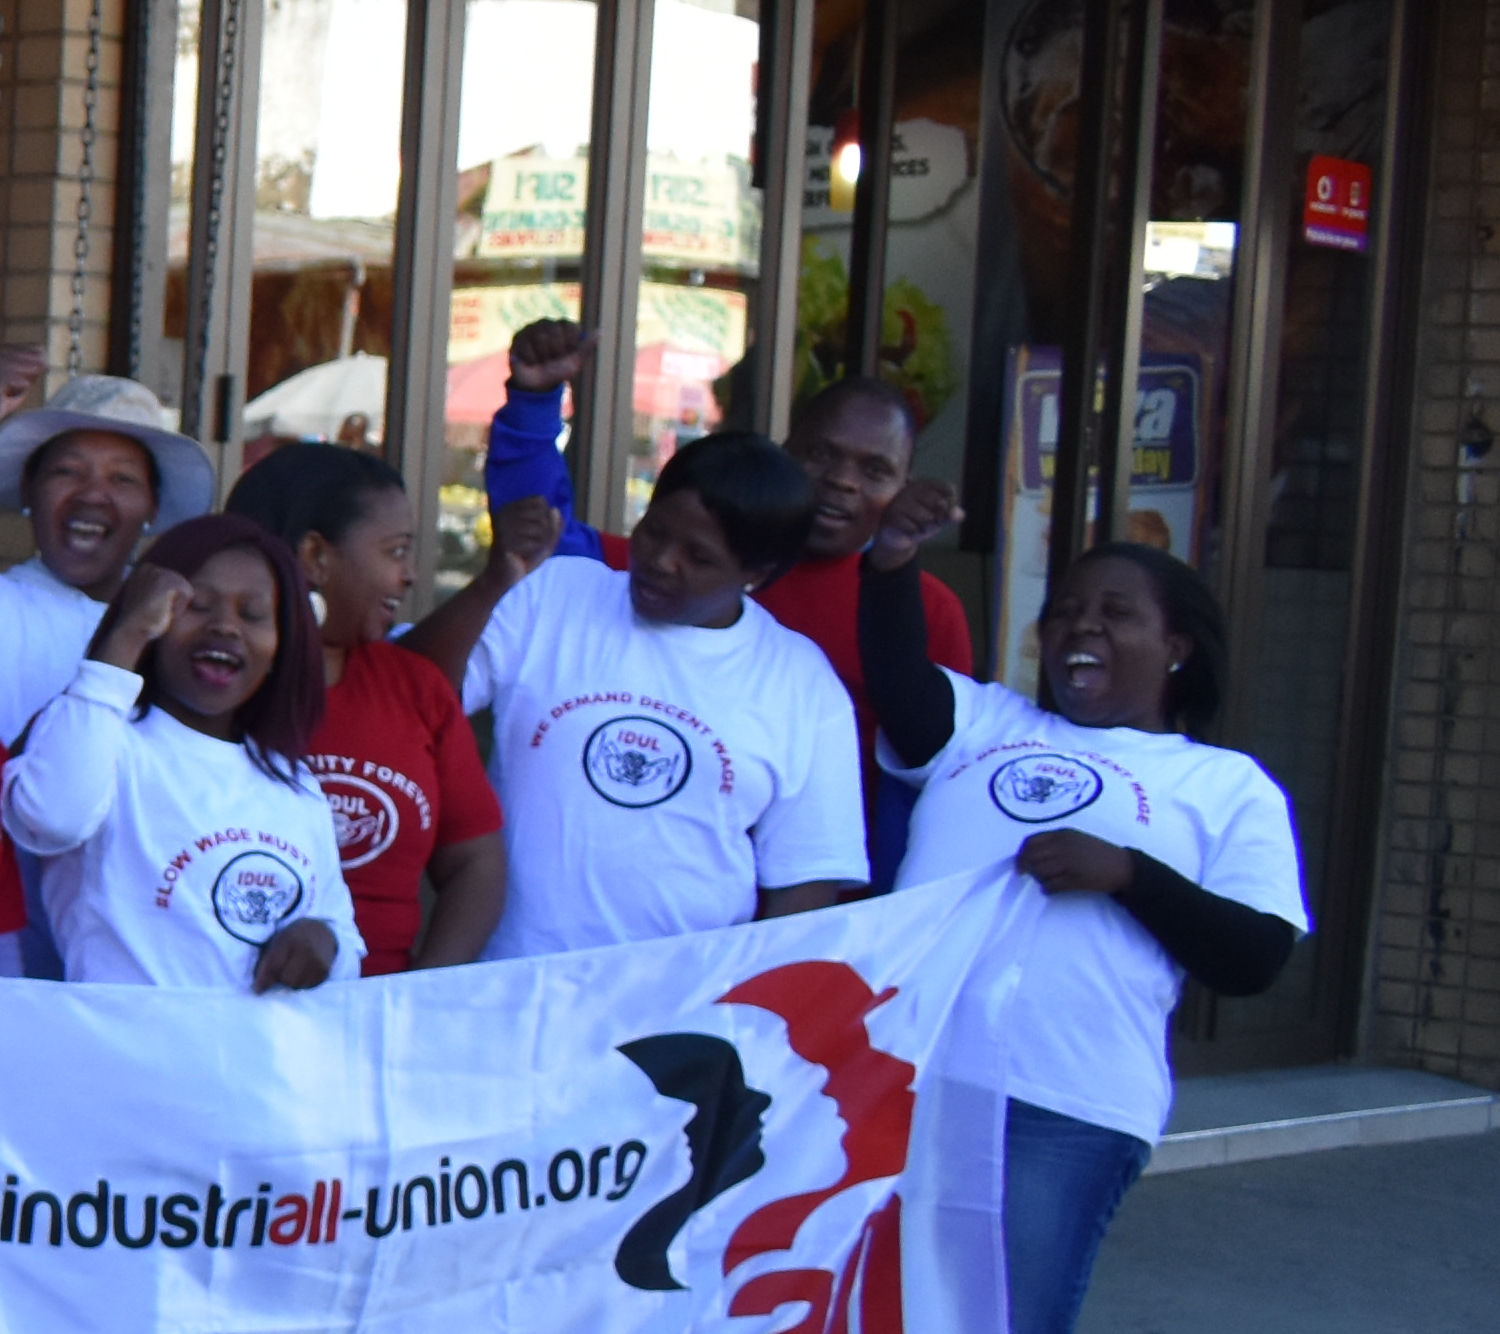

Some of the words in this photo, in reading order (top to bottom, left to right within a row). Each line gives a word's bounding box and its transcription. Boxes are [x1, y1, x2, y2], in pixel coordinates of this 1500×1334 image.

[550, 691, 633, 719] DEMAND
[639, 695, 713, 736] DECENT
[712, 739, 736, 795] WAGE
[616, 730, 661, 752] IDUL
[362, 760, 432, 831] FOREVER
[194, 827, 251, 852] WAGE
[238, 871, 277, 888] IDUL
